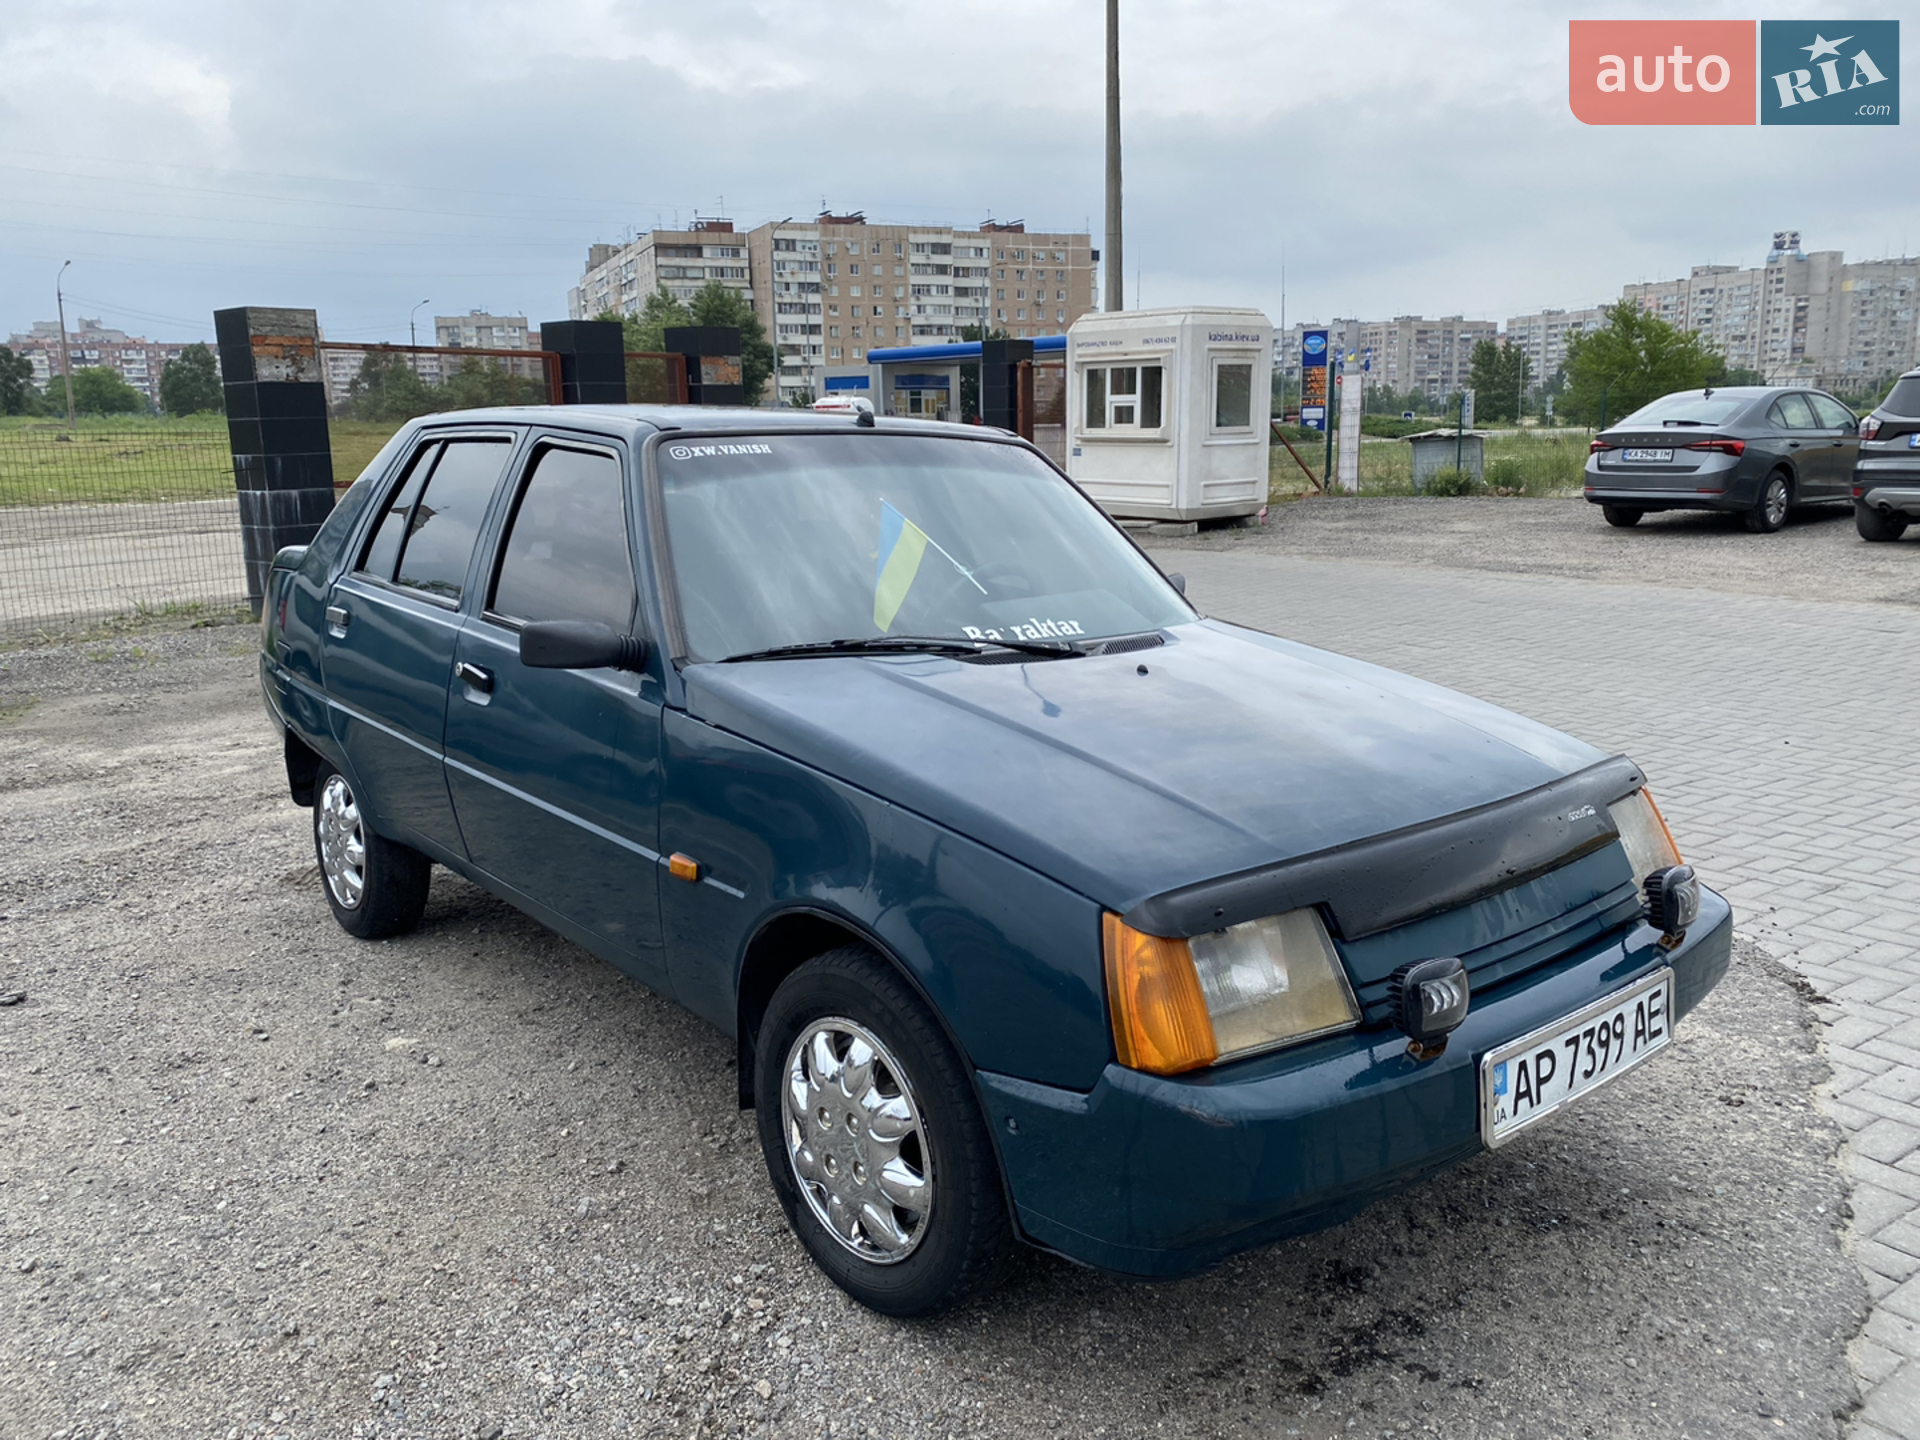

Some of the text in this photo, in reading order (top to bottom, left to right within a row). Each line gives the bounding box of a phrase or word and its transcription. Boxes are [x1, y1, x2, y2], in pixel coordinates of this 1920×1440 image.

[1208, 331, 1260, 343] kabina.kiev.ua
[690, 444, 772, 457] XW.VANISH
[961, 617, 1085, 648] Baraktar
[1512, 989, 1663, 1117] AP 7399 AE
